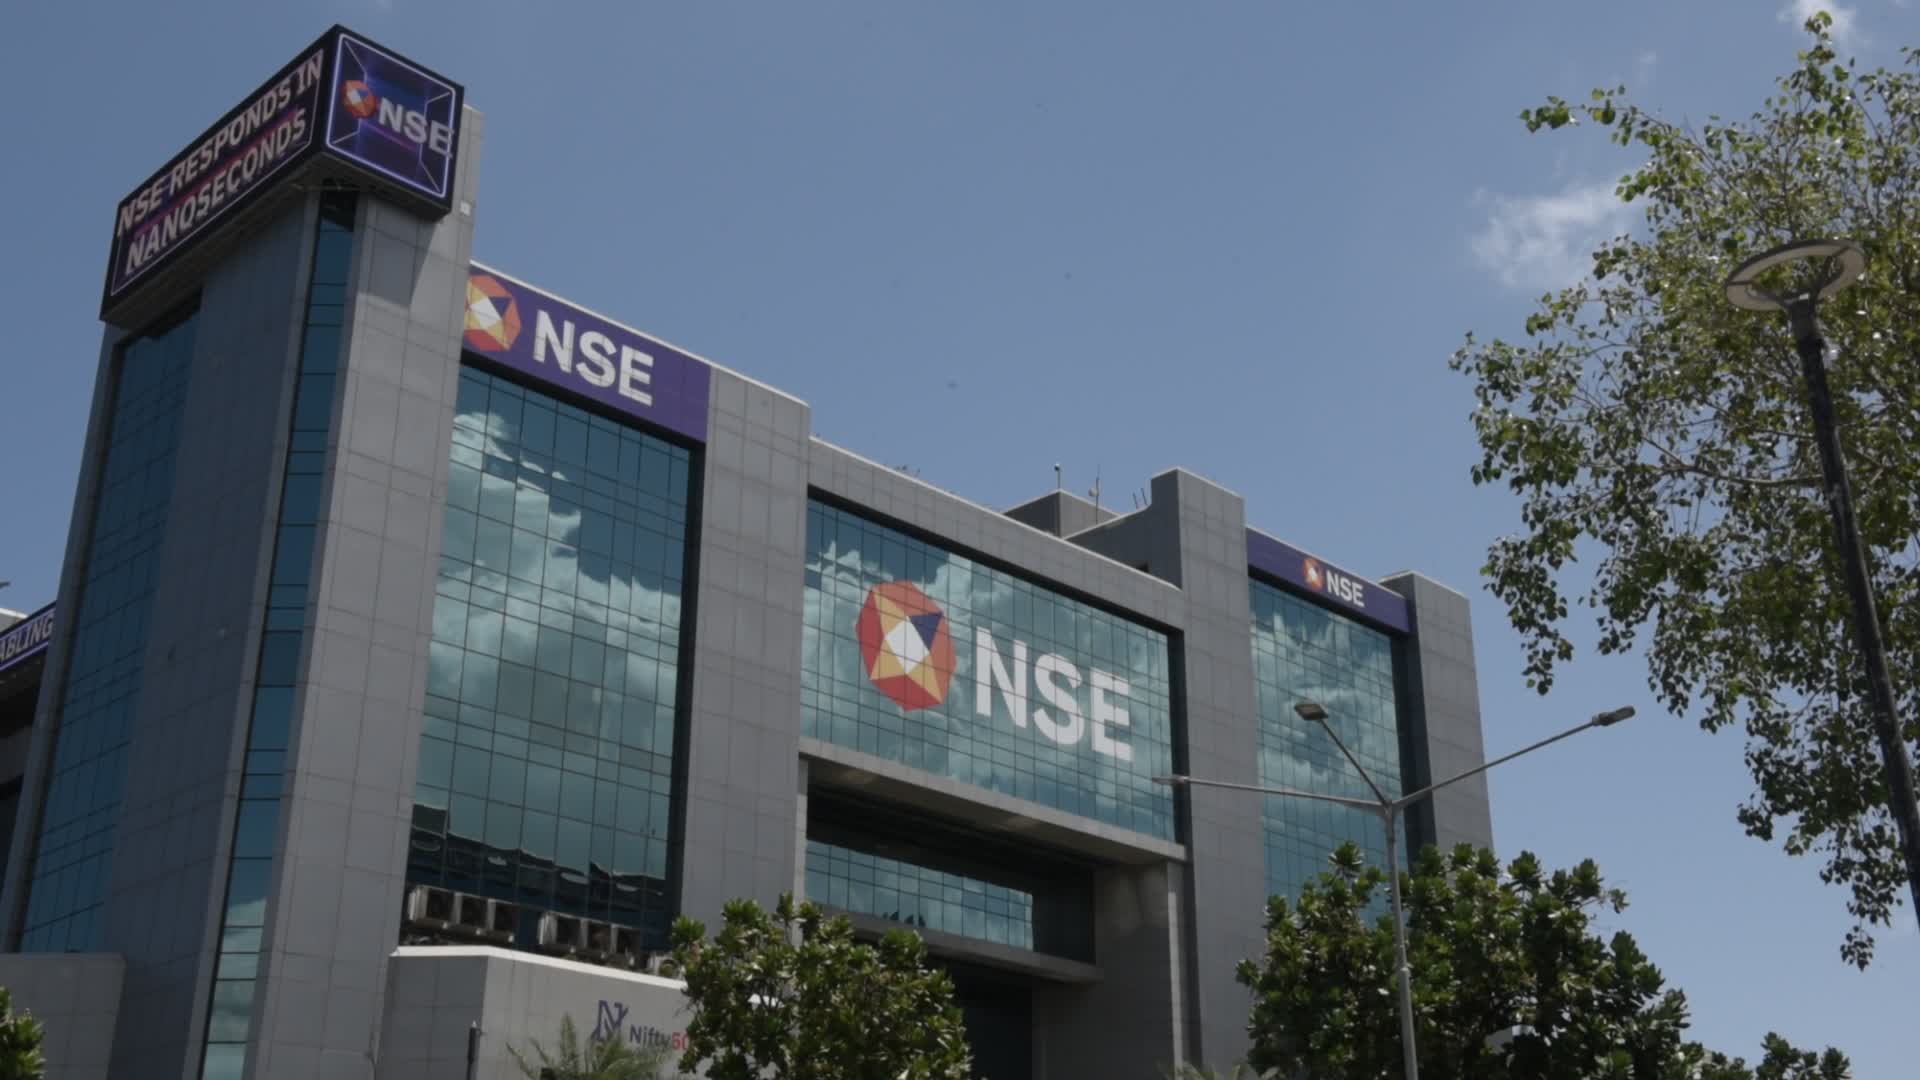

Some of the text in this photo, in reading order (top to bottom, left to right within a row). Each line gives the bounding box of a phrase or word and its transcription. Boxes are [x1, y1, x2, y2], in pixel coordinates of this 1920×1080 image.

[117, 49, 324, 237] NSE RESPONDS IN
[378, 97, 454, 159] NSE
[125, 108, 307, 275] NANOSECONDS
[533, 309, 654, 407] NSE
[1326, 569, 1365, 608] NSE
[976, 626, 1133, 762] NSE
